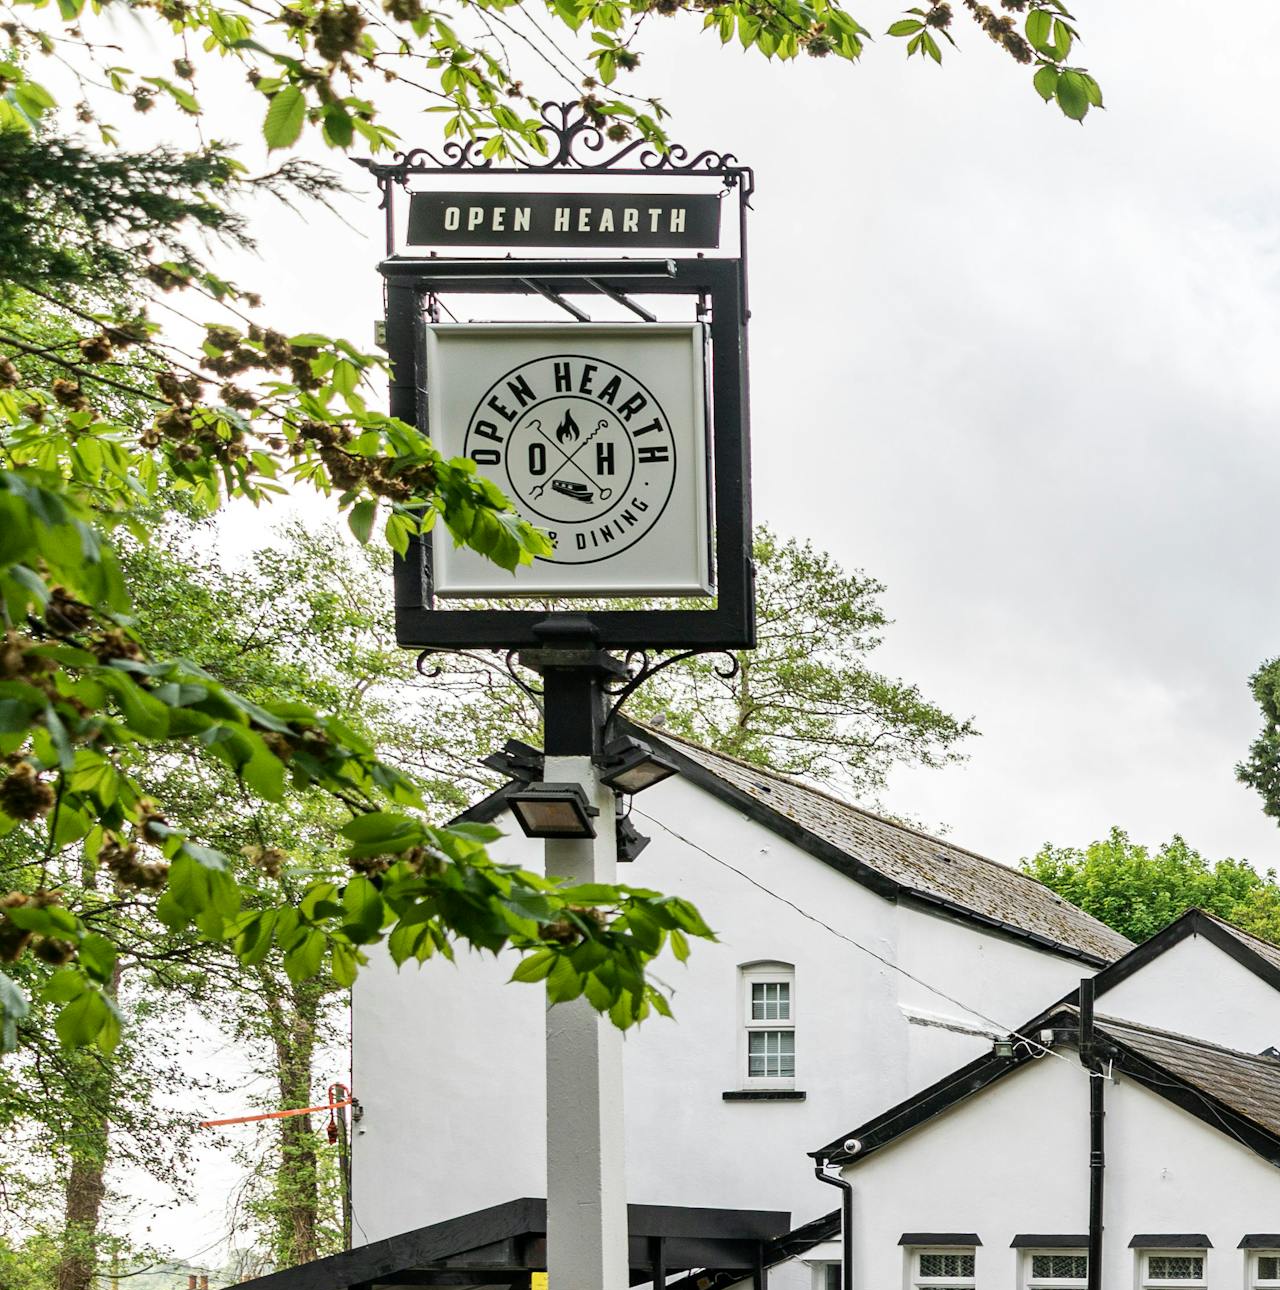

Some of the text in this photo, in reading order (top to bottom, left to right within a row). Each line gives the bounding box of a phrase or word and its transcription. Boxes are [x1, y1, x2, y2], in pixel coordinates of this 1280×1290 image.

[444, 206, 687, 233] OPEN HEARTH
[471, 362, 669, 465] OPEN HEARTH
[528, 442, 615, 475] O H
[575, 497, 649, 550] DINING
